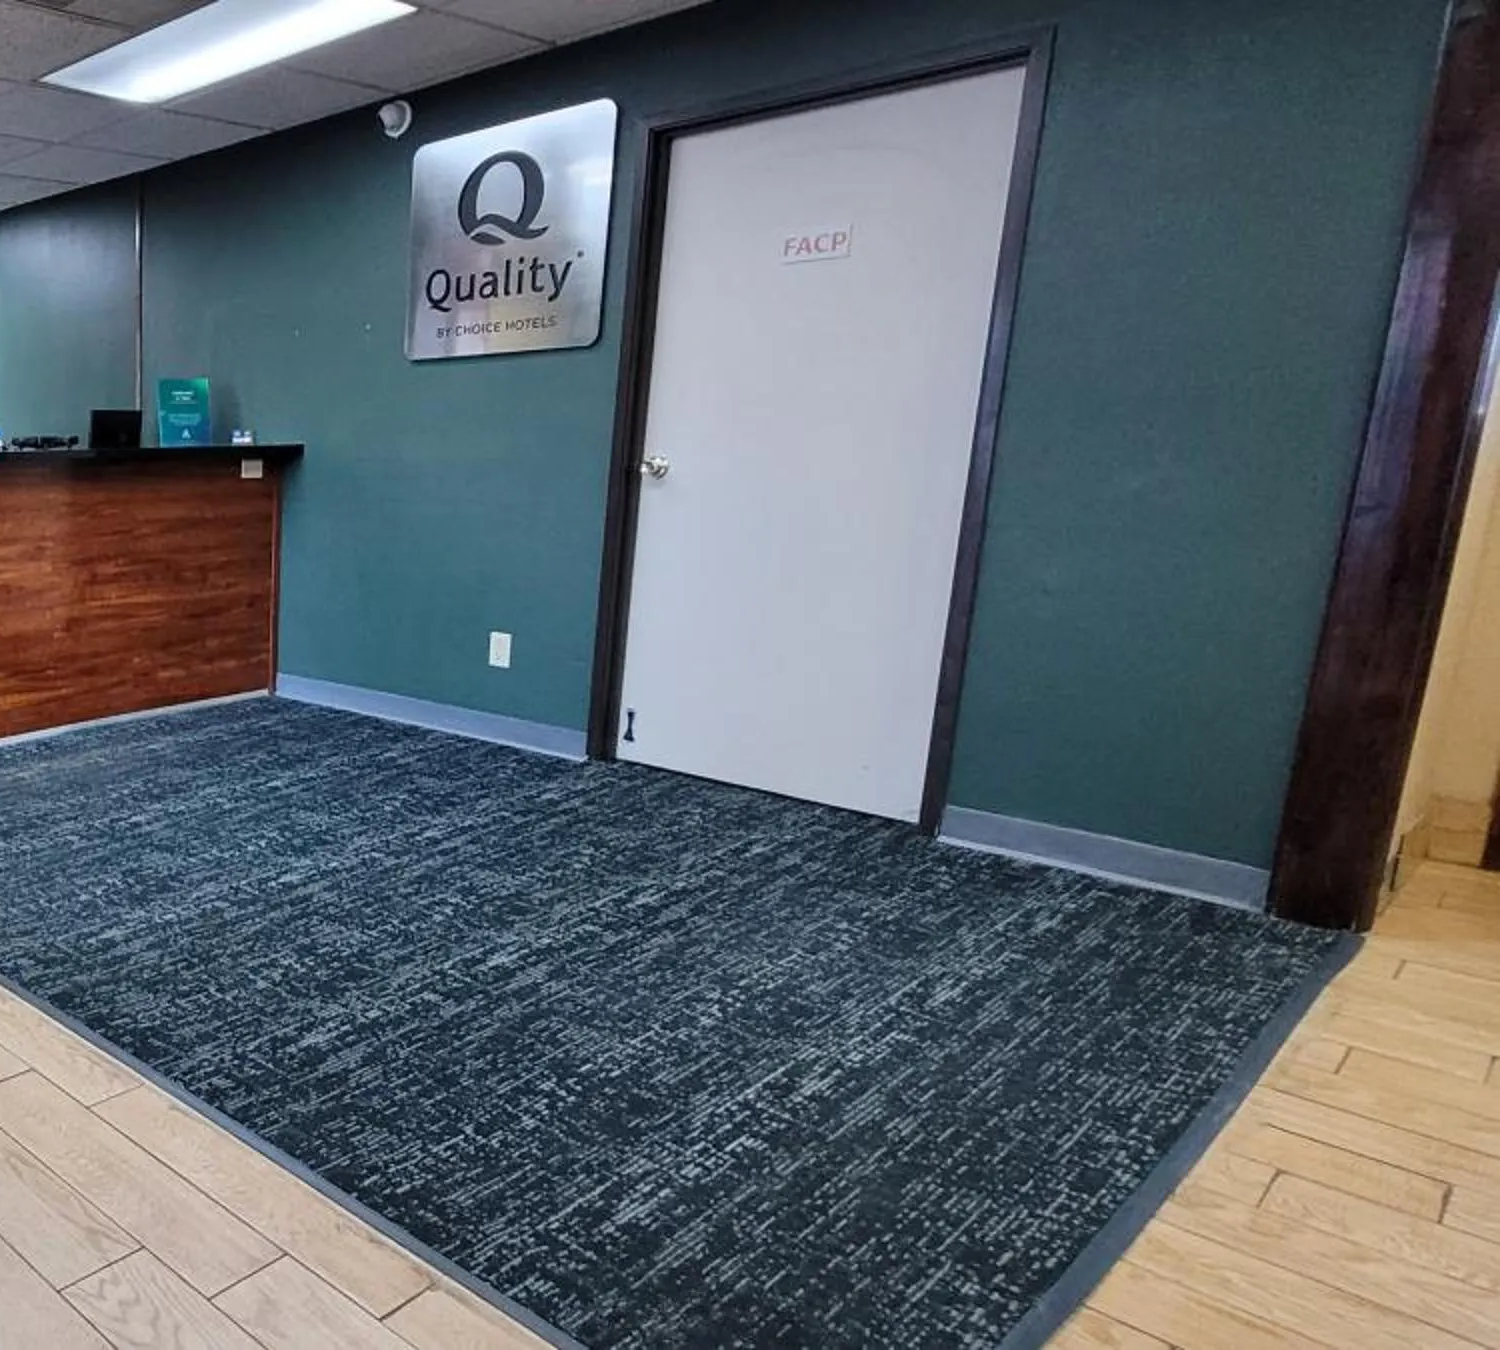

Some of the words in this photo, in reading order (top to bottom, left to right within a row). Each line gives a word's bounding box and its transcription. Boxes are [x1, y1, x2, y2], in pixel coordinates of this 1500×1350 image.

[457, 150, 549, 246] Q
[783, 230, 847, 257] FACP
[425, 255, 573, 313] Quality
[436, 326, 453, 339] BY
[455, 320, 502, 337] CHOICE
[505, 315, 559, 332] HOTELS
